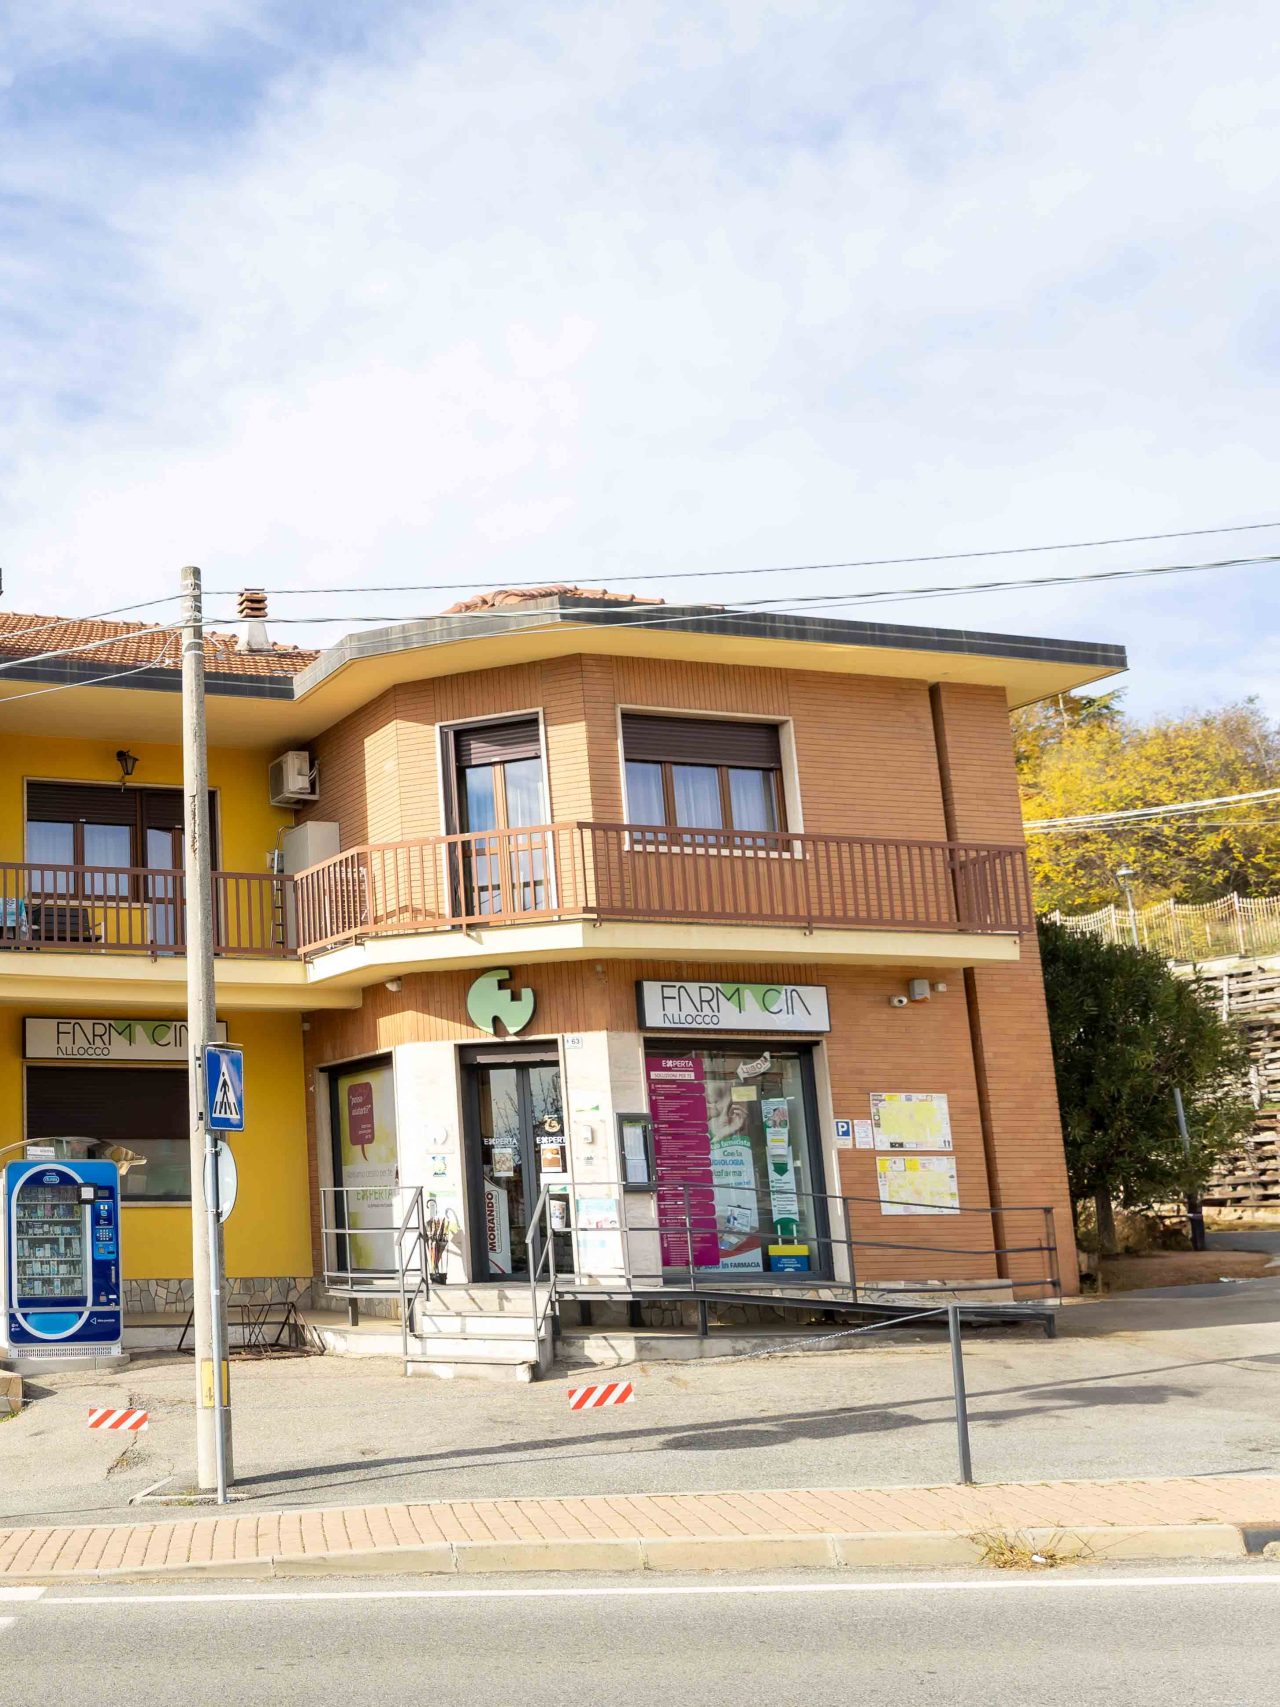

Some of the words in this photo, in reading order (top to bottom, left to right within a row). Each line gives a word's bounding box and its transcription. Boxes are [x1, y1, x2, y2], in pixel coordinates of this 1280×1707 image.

[661, 984, 811, 1016] FARMACIA
[663, 1013, 720, 1026] ALLOCCO
[56, 1046, 111, 1057] ALLOCCO
[837, 1122, 848, 1136] P
[536, 1136, 566, 1145] EXPERT
[486, 1192, 497, 1252] MORANDO
